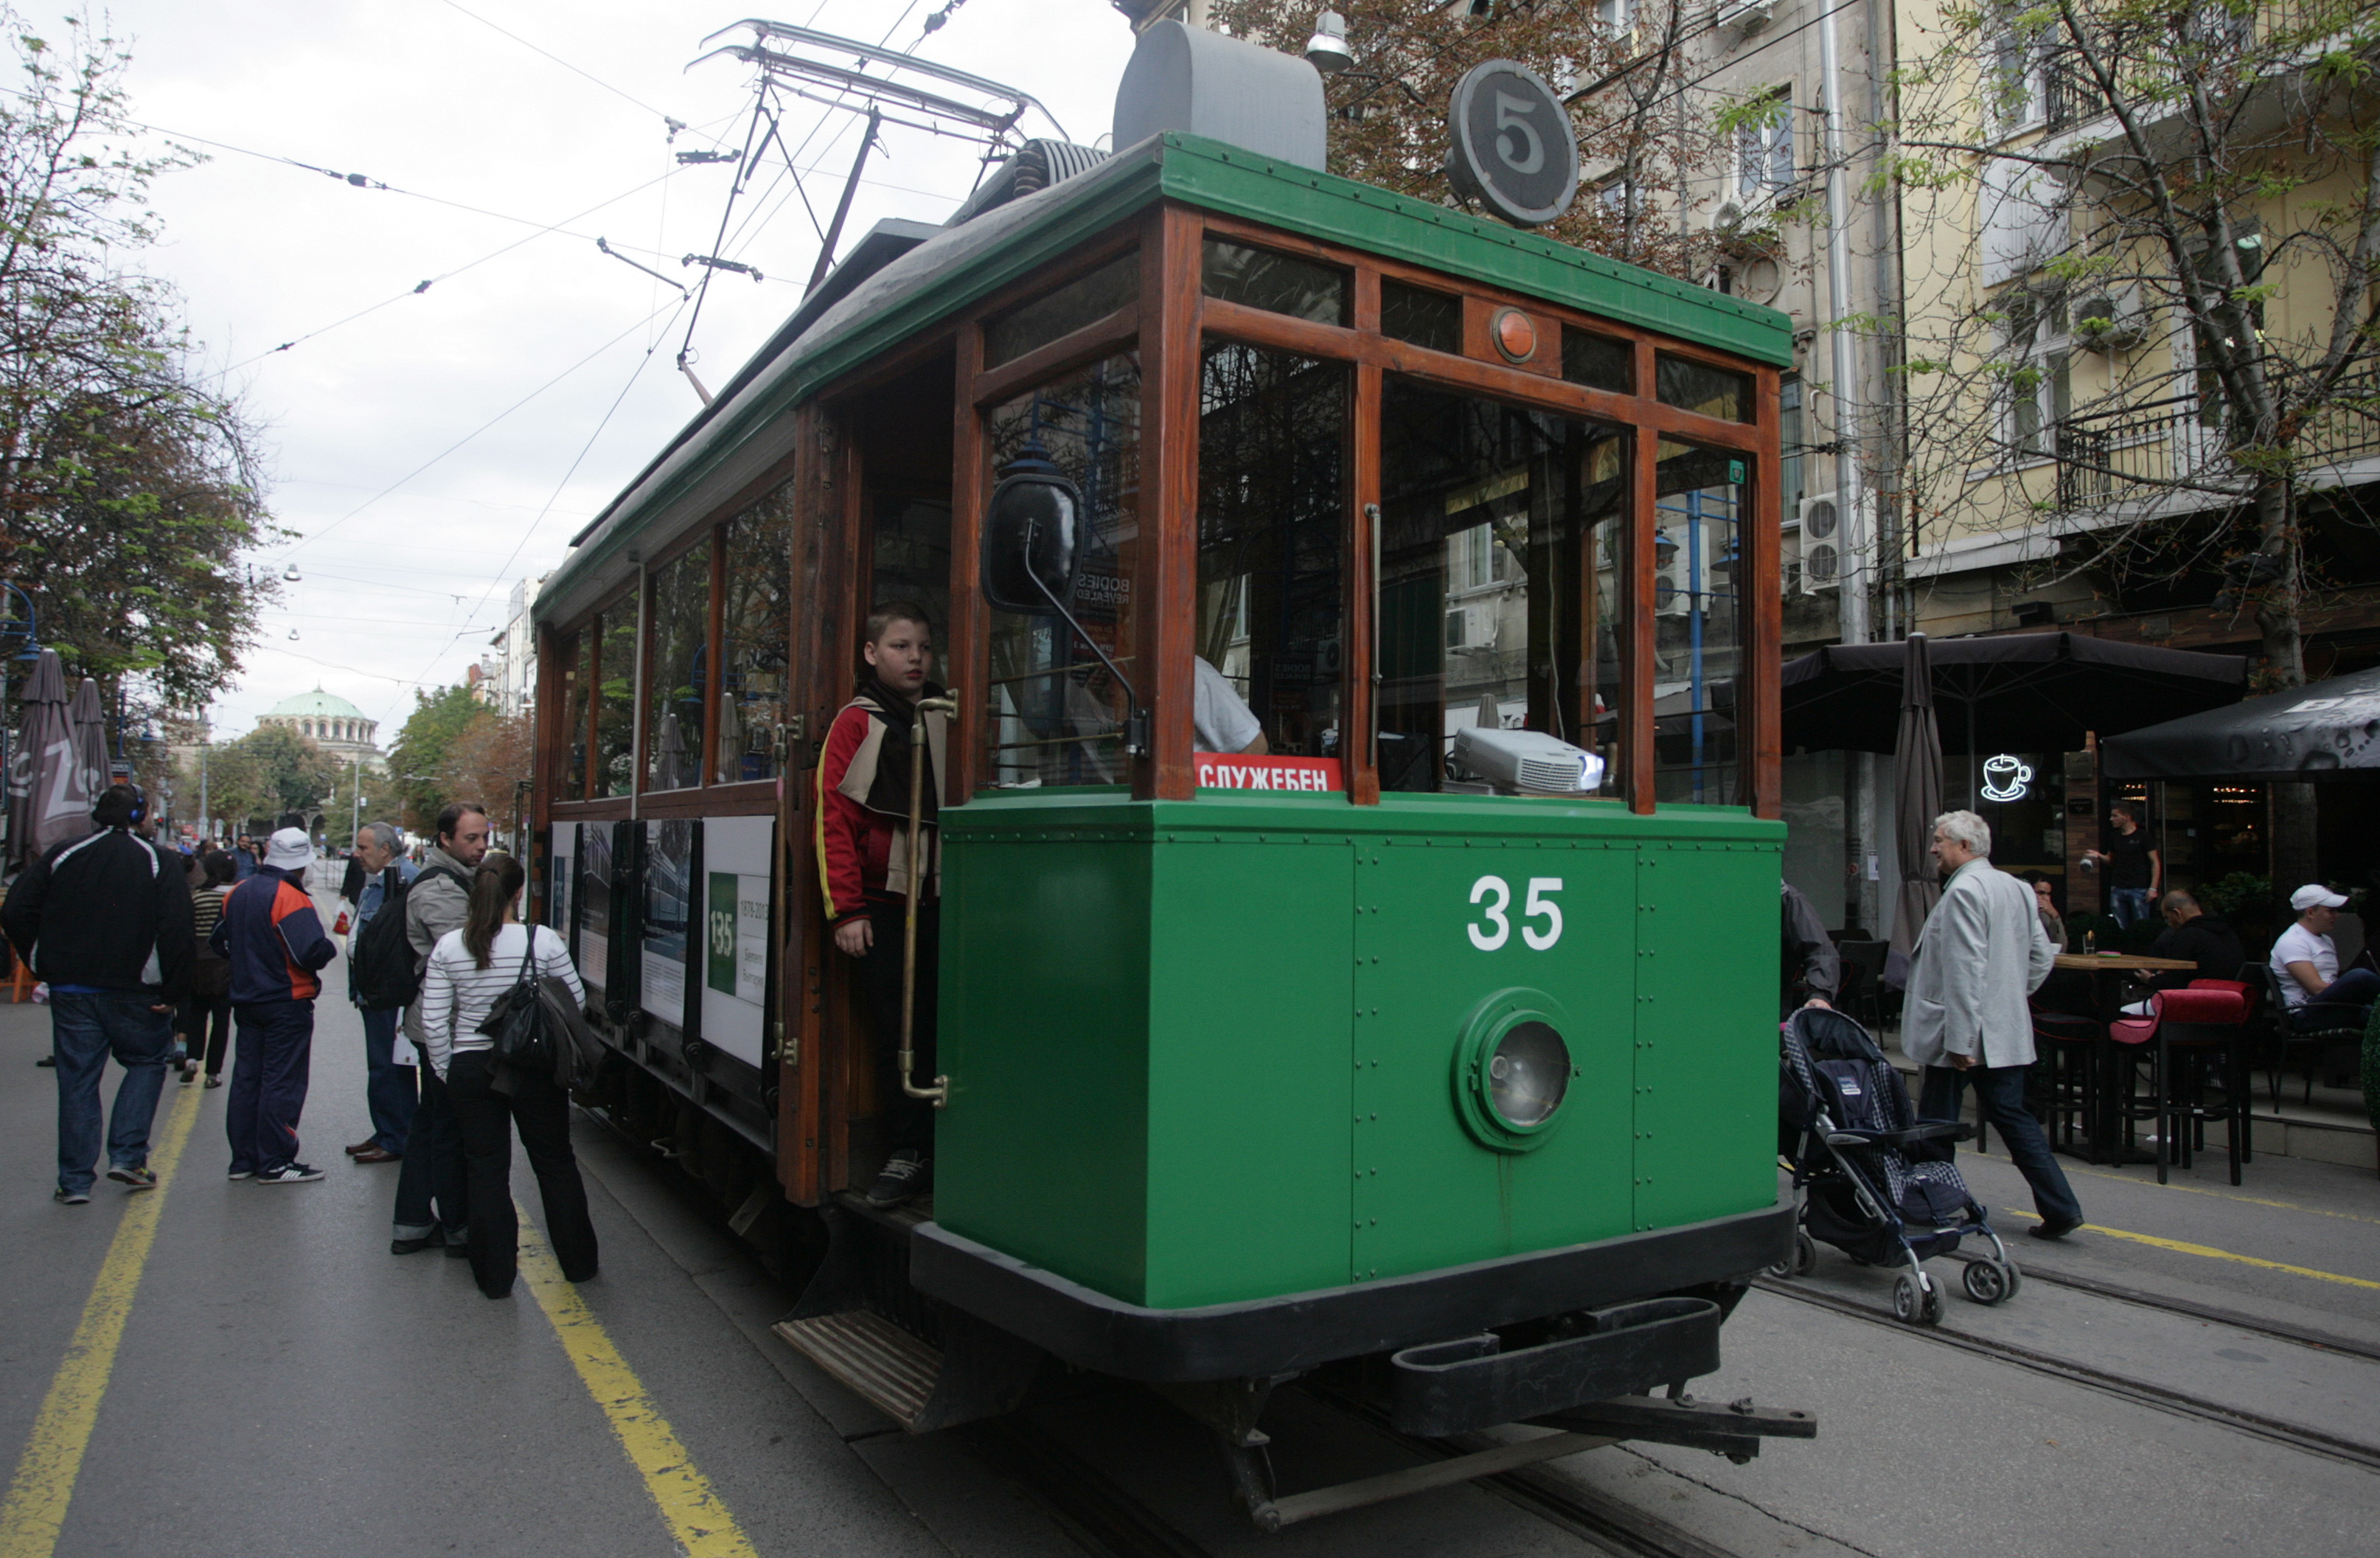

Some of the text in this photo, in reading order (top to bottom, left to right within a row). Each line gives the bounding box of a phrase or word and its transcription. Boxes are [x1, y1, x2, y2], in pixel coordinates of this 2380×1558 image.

[1495, 88, 1545, 175] 5
[1199, 764, 1328, 792] СЛУЖЕБЕН
[710, 910, 733, 957] 135
[1467, 874, 1564, 952] 35
